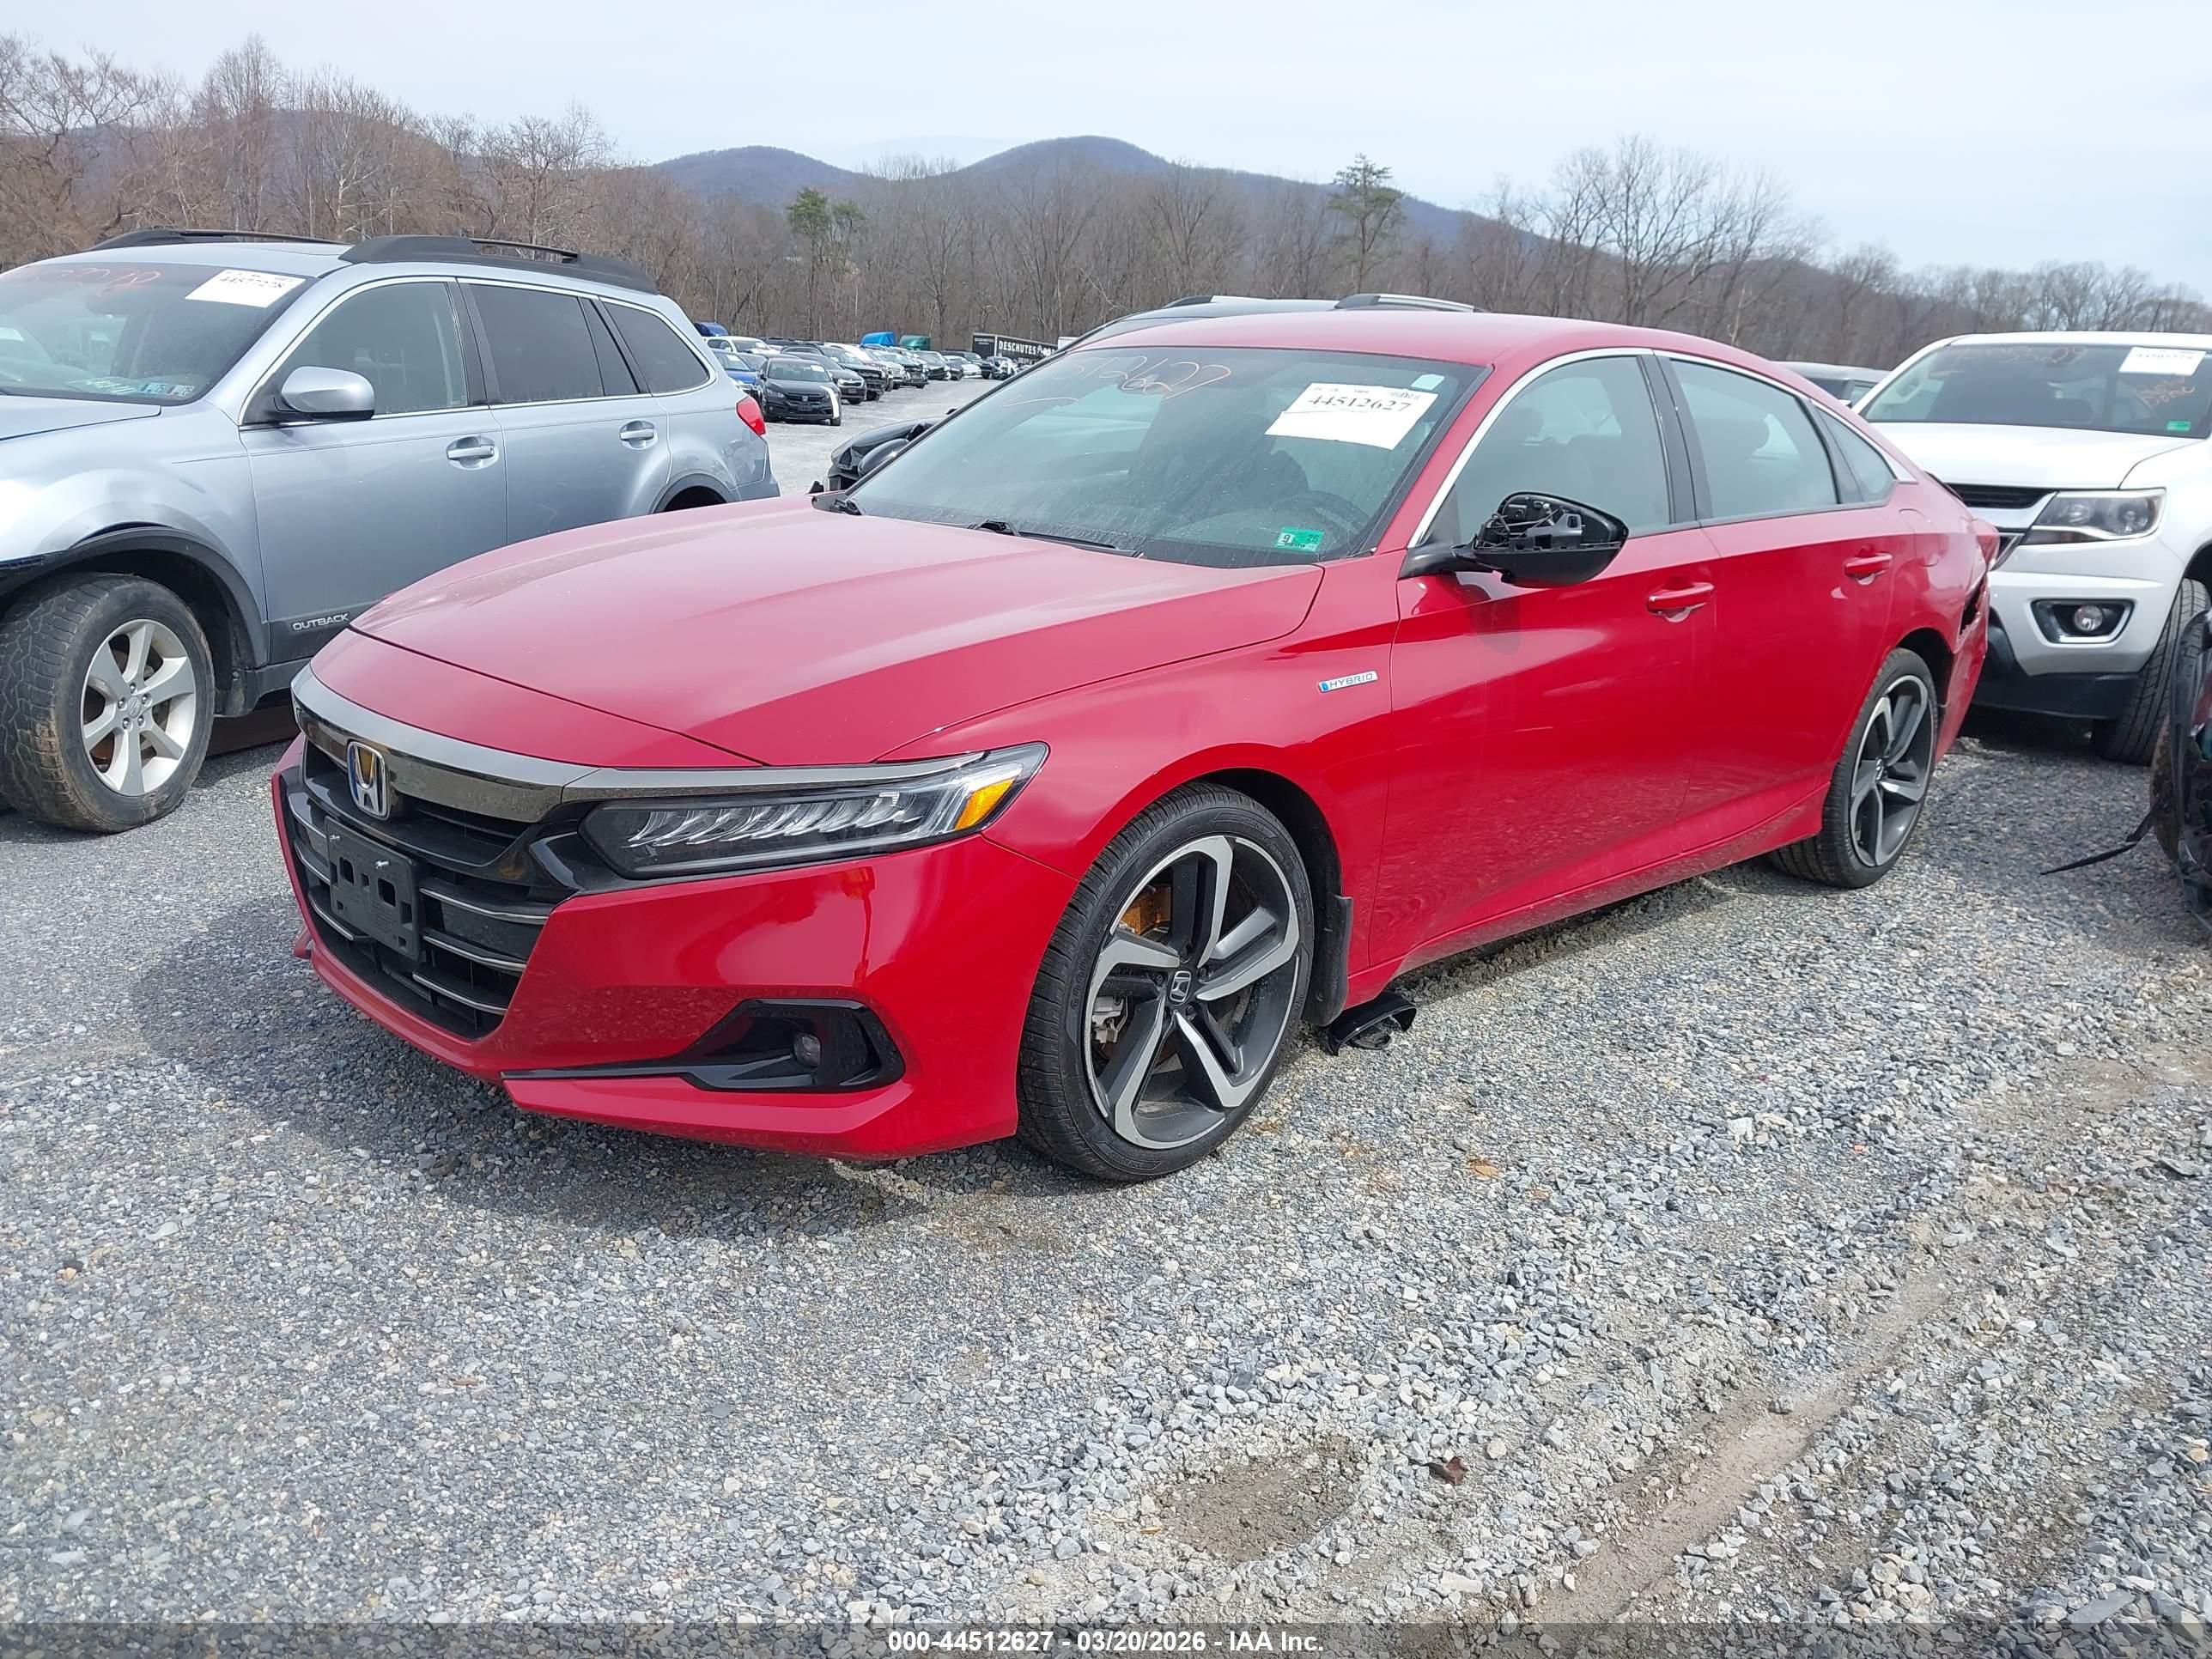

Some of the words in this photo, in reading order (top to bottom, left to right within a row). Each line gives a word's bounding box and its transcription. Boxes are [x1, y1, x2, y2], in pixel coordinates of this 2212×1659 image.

[999, 340, 1036, 356] DESCHUTES
[1309, 396, 1413, 412] 44512627
[1283, 534, 1291, 543] 9
[292, 613, 349, 631] OUTBACK
[1329, 672, 1373, 689] HYBRID
